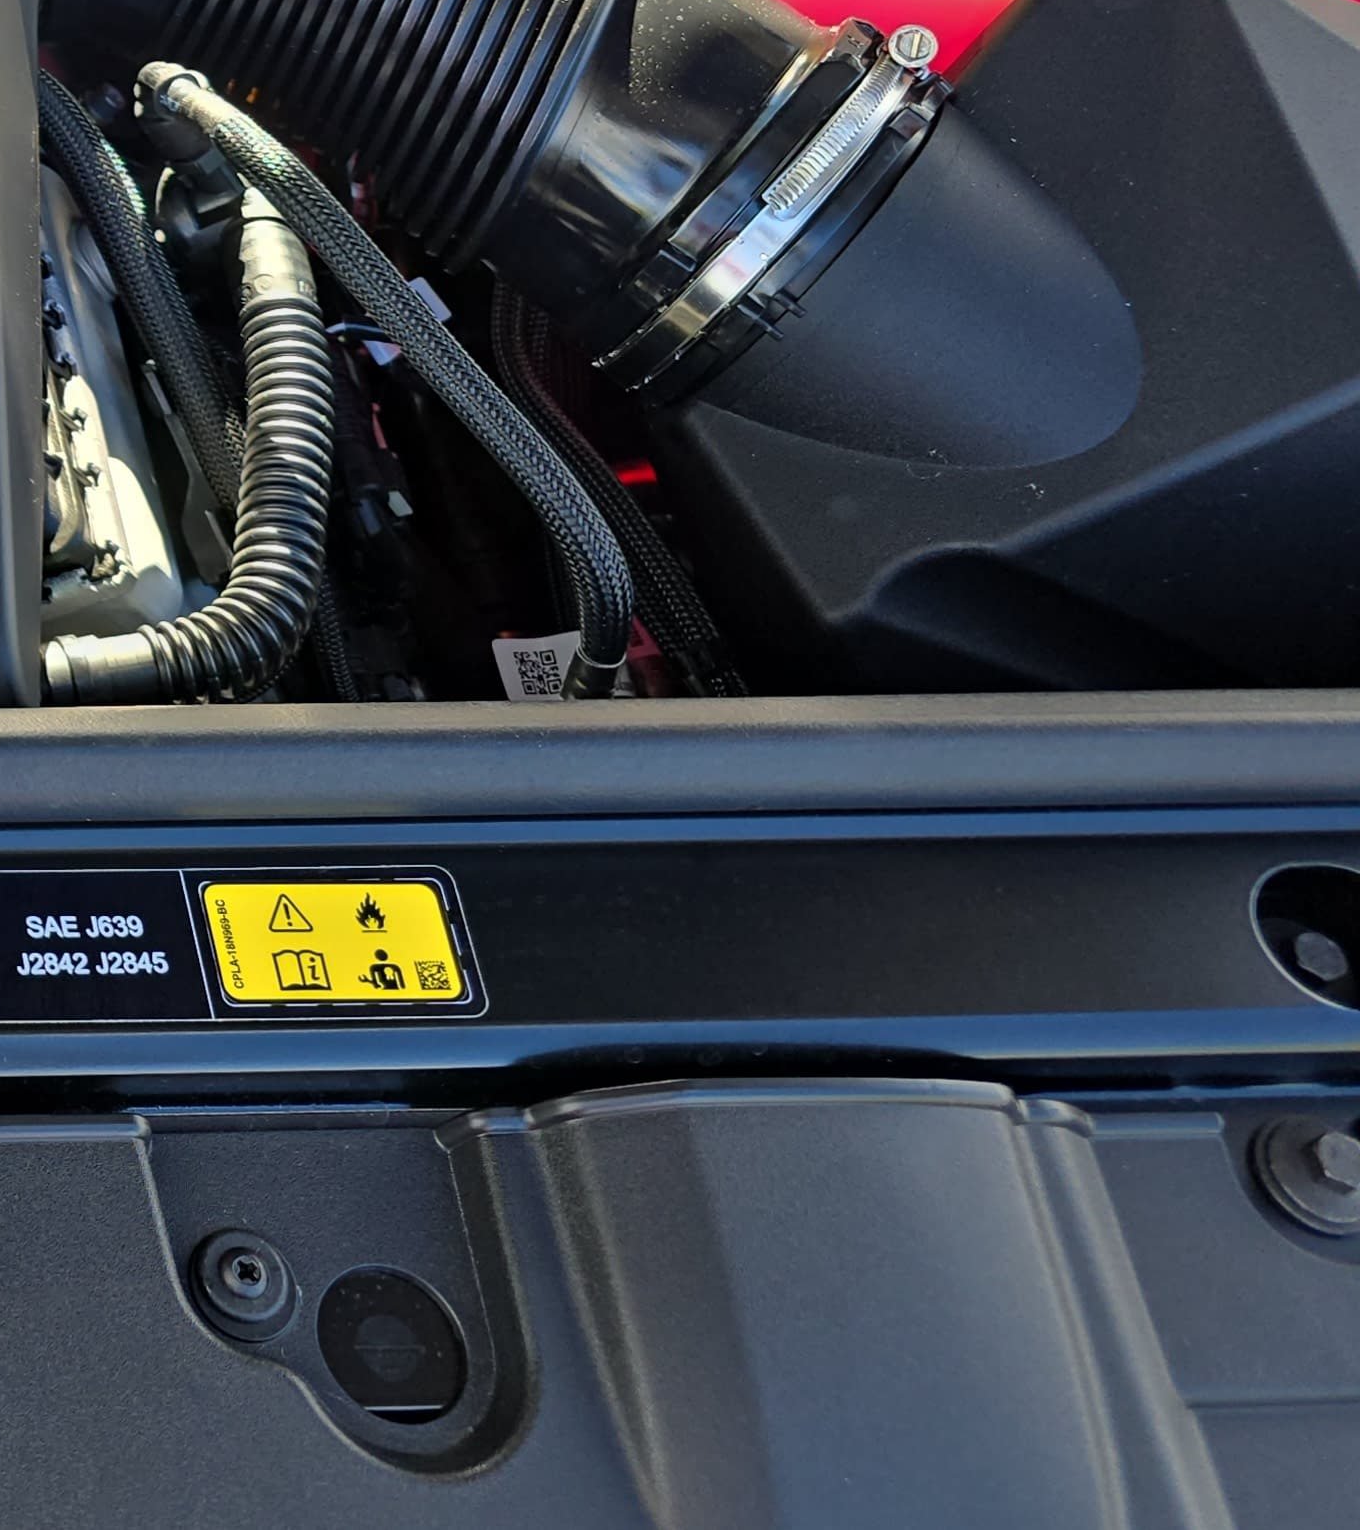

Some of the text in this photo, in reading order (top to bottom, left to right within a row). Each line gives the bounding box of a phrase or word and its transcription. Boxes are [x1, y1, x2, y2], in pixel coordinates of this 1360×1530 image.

[26, 915, 144, 939] SAE J639
[16, 952, 169, 976] J2842 J2845
